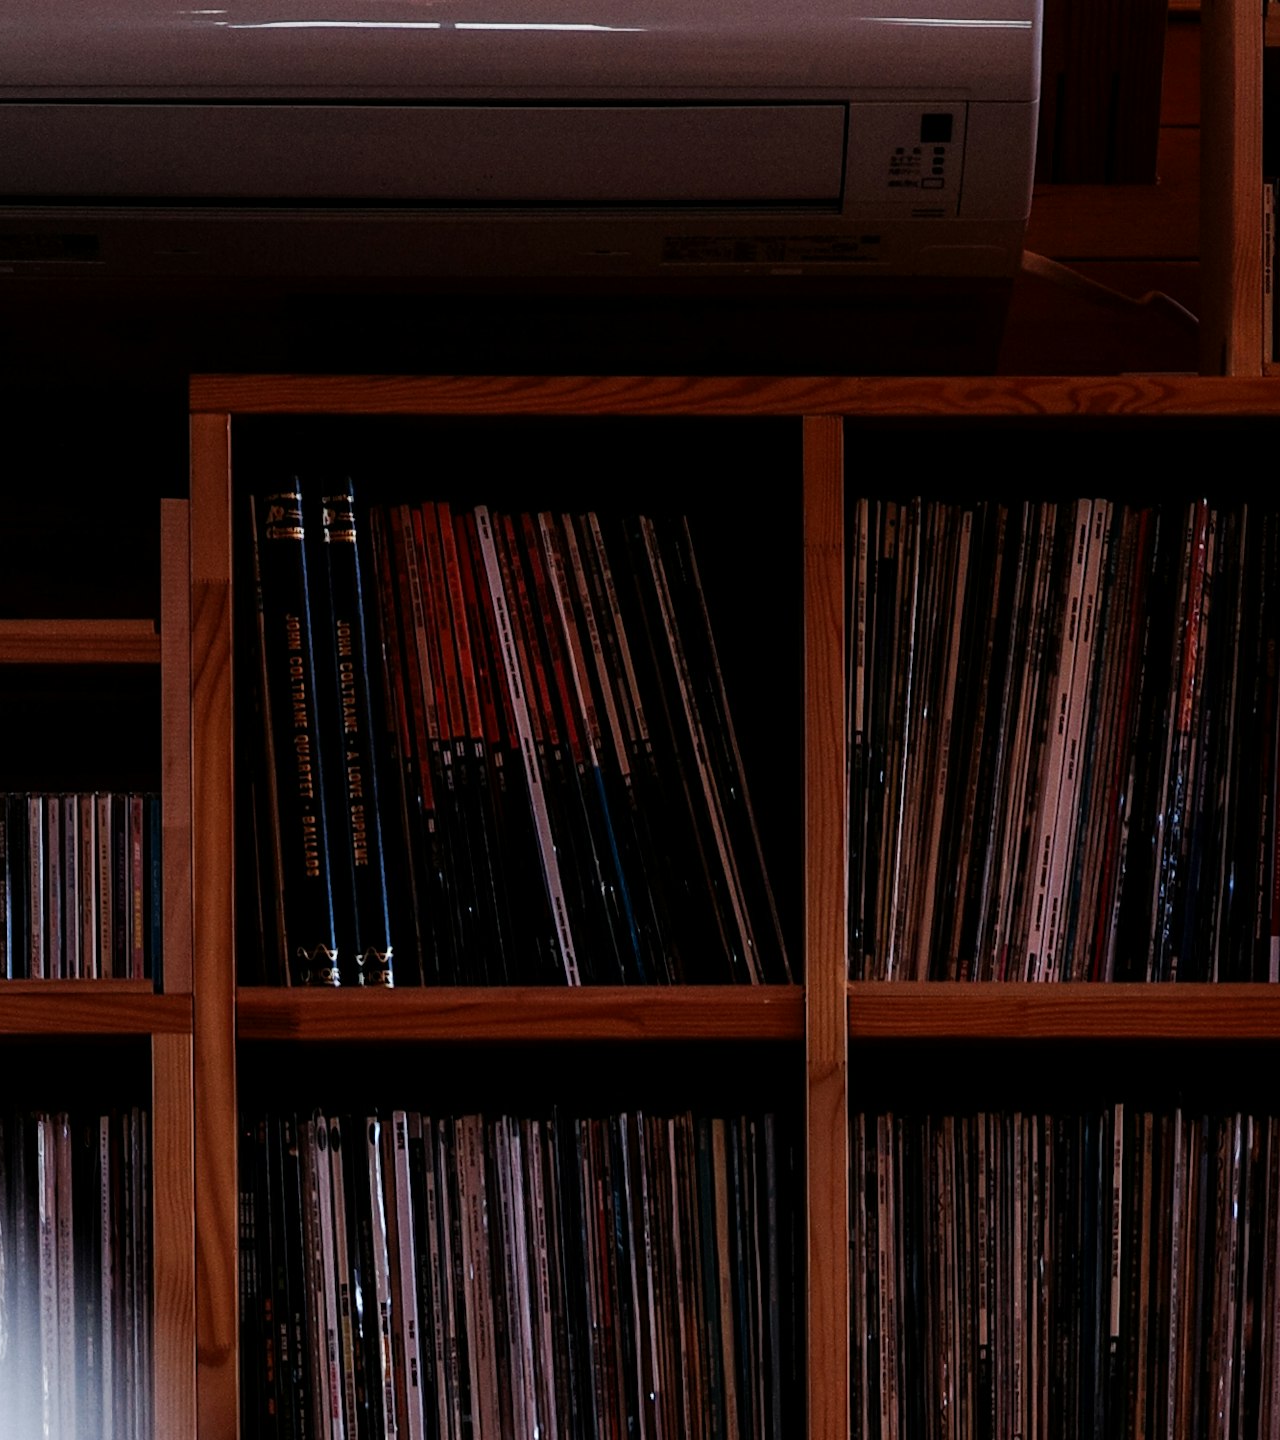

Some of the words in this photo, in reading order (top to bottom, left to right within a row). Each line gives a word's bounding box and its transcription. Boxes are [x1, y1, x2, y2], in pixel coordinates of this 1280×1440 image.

[283, 612, 301, 650] JOHN
[335, 618, 352, 656] JOHN
[287, 656, 308, 728] COLTRANE
[339, 662, 358, 734] COLTRANE
[294, 734, 314, 800] QUARTET
[345, 750, 360, 760] A
[346, 766, 363, 800] LOVE
[301, 814, 321, 876] BALLADS
[349, 804, 368, 866] SUPREME
